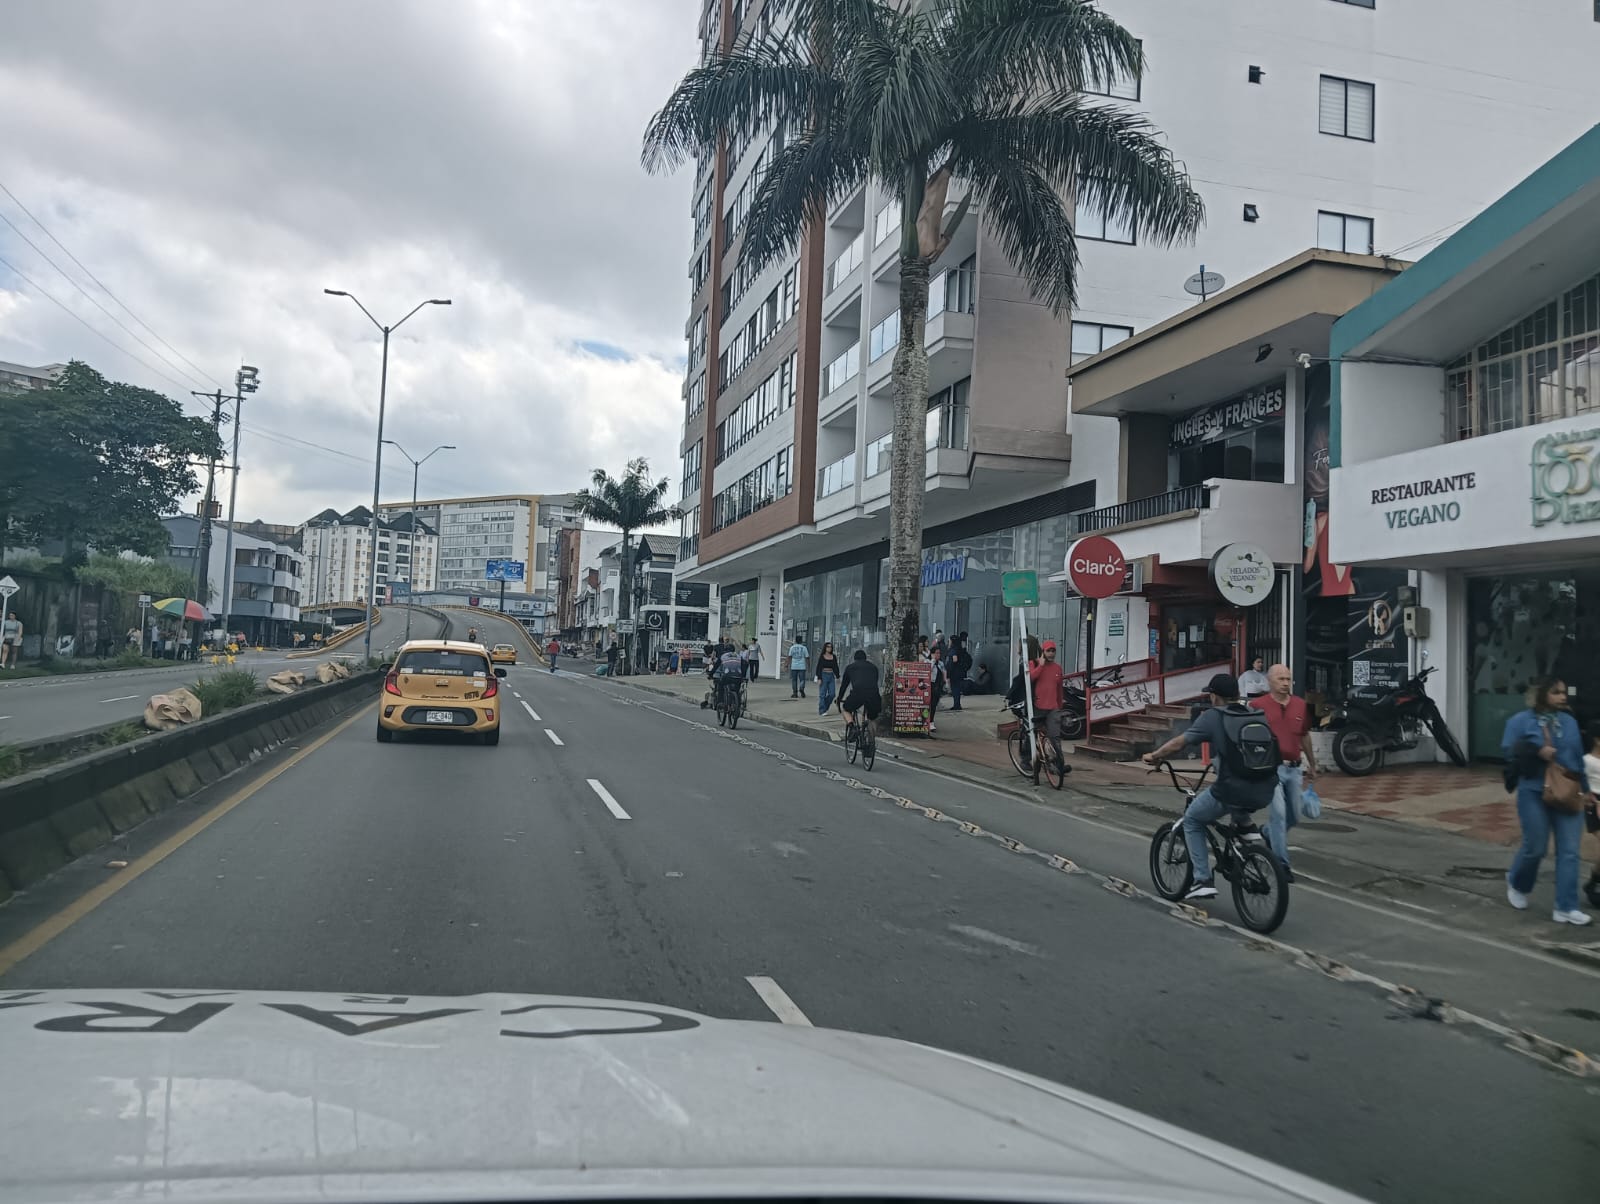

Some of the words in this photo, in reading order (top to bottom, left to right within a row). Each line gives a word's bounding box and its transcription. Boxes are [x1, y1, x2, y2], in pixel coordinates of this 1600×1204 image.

[1174, 414, 1211, 442] INGLES
[1371, 472, 1476, 504] RESTAURANTE
[1384, 501, 1461, 529] VEGANO
[1073, 558, 1116, 577] Claro
[0, 1000, 701, 1038] CAR
